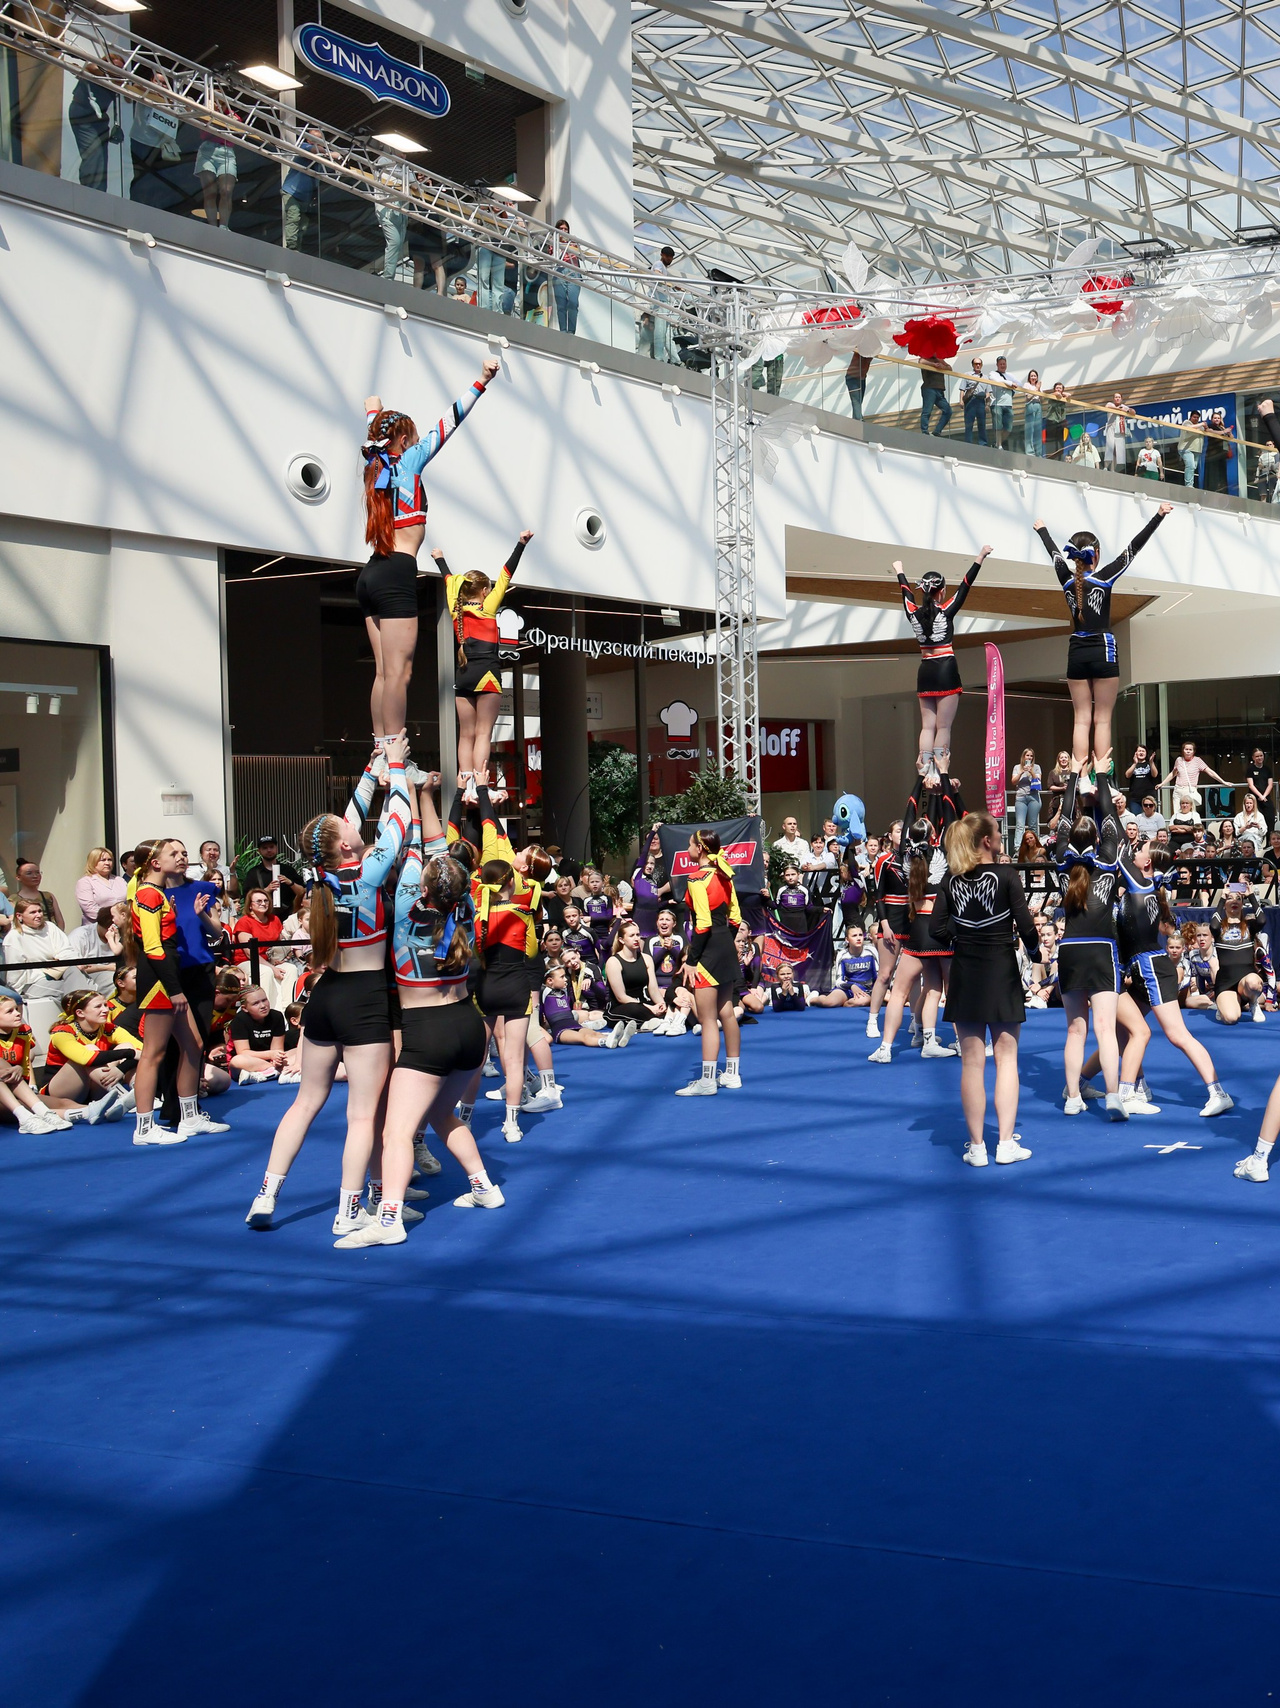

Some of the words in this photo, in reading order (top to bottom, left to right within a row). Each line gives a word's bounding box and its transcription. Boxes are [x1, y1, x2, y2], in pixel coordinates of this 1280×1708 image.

[311, 35, 438, 106] CINNABON
[153, 112, 177, 128] ECRU
[528, 627, 653, 660] Французский
[658, 646, 714, 669] пекарь
[990, 656, 998, 691] School
[989, 694, 997, 724] Cheer
[989, 726, 997, 751] Ural
